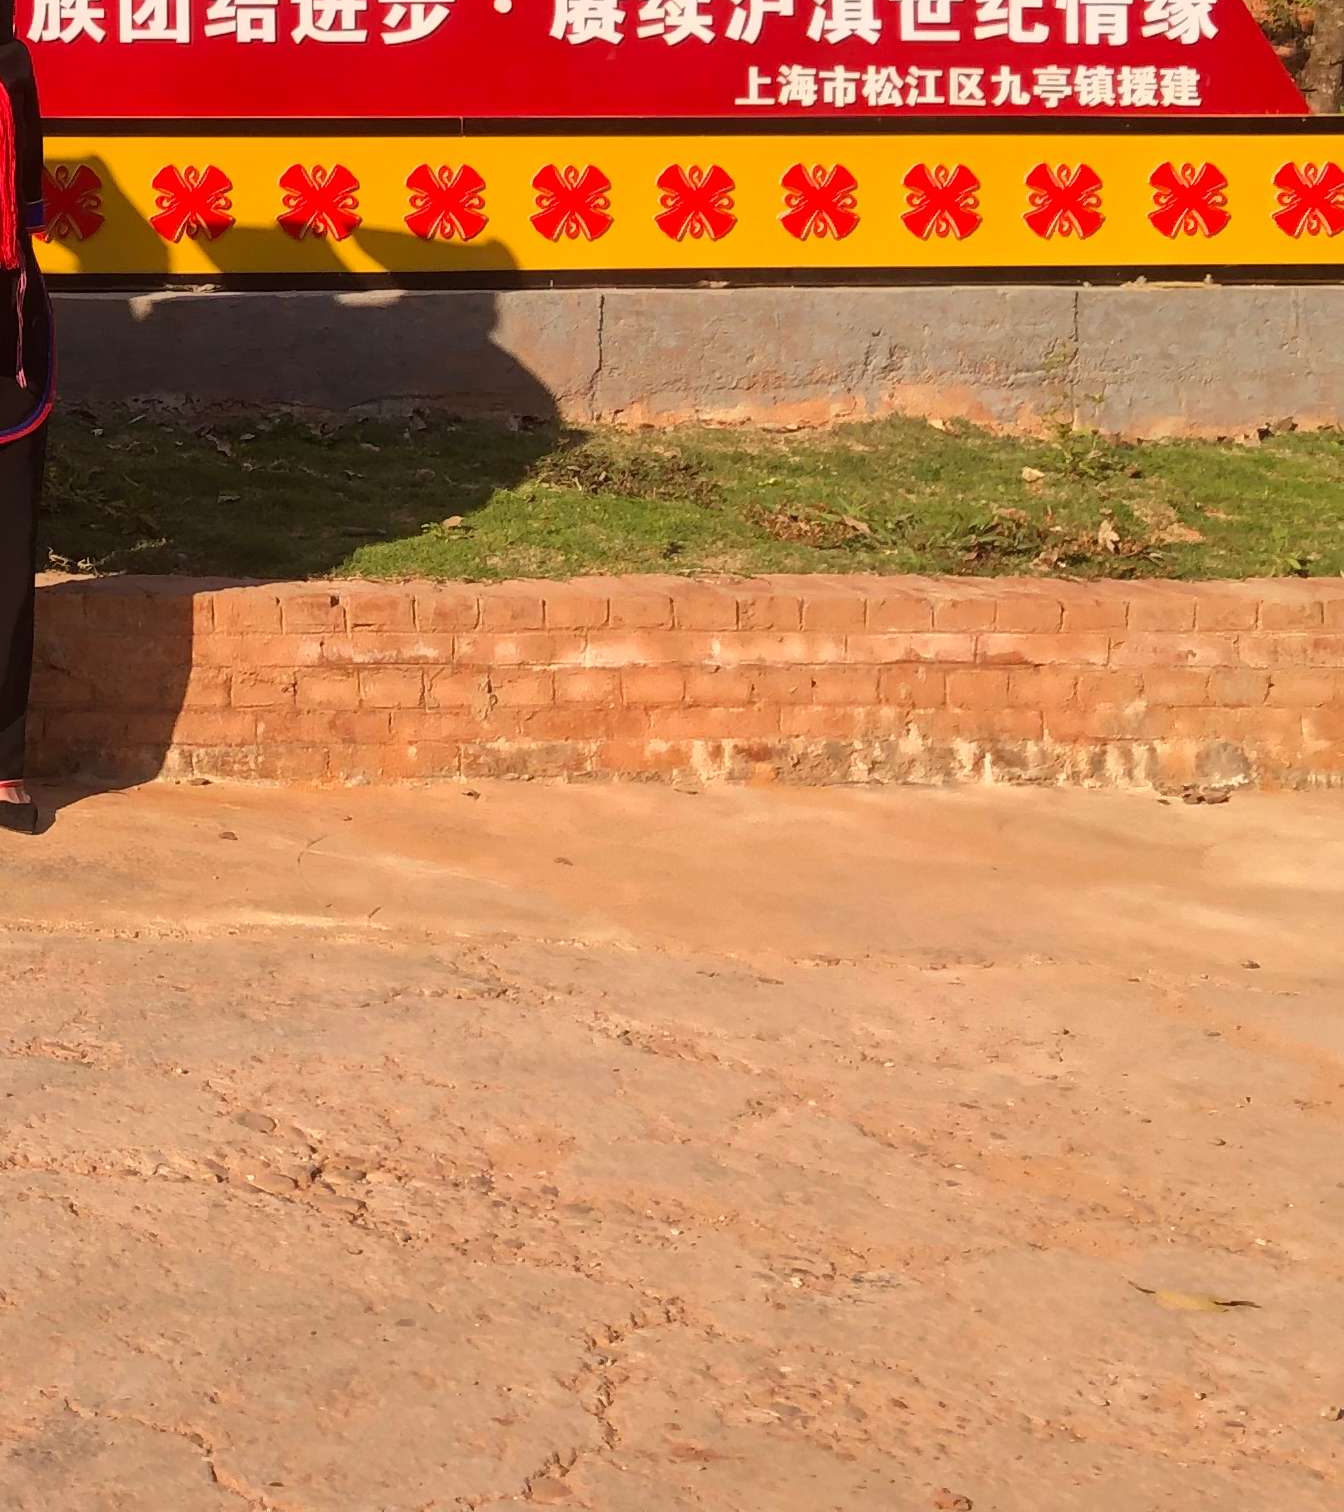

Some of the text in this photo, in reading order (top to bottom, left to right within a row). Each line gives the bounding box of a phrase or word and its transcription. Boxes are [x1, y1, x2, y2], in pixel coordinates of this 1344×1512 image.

[734, 64, 1202, 108] 上海市松江区九亭镇援建
